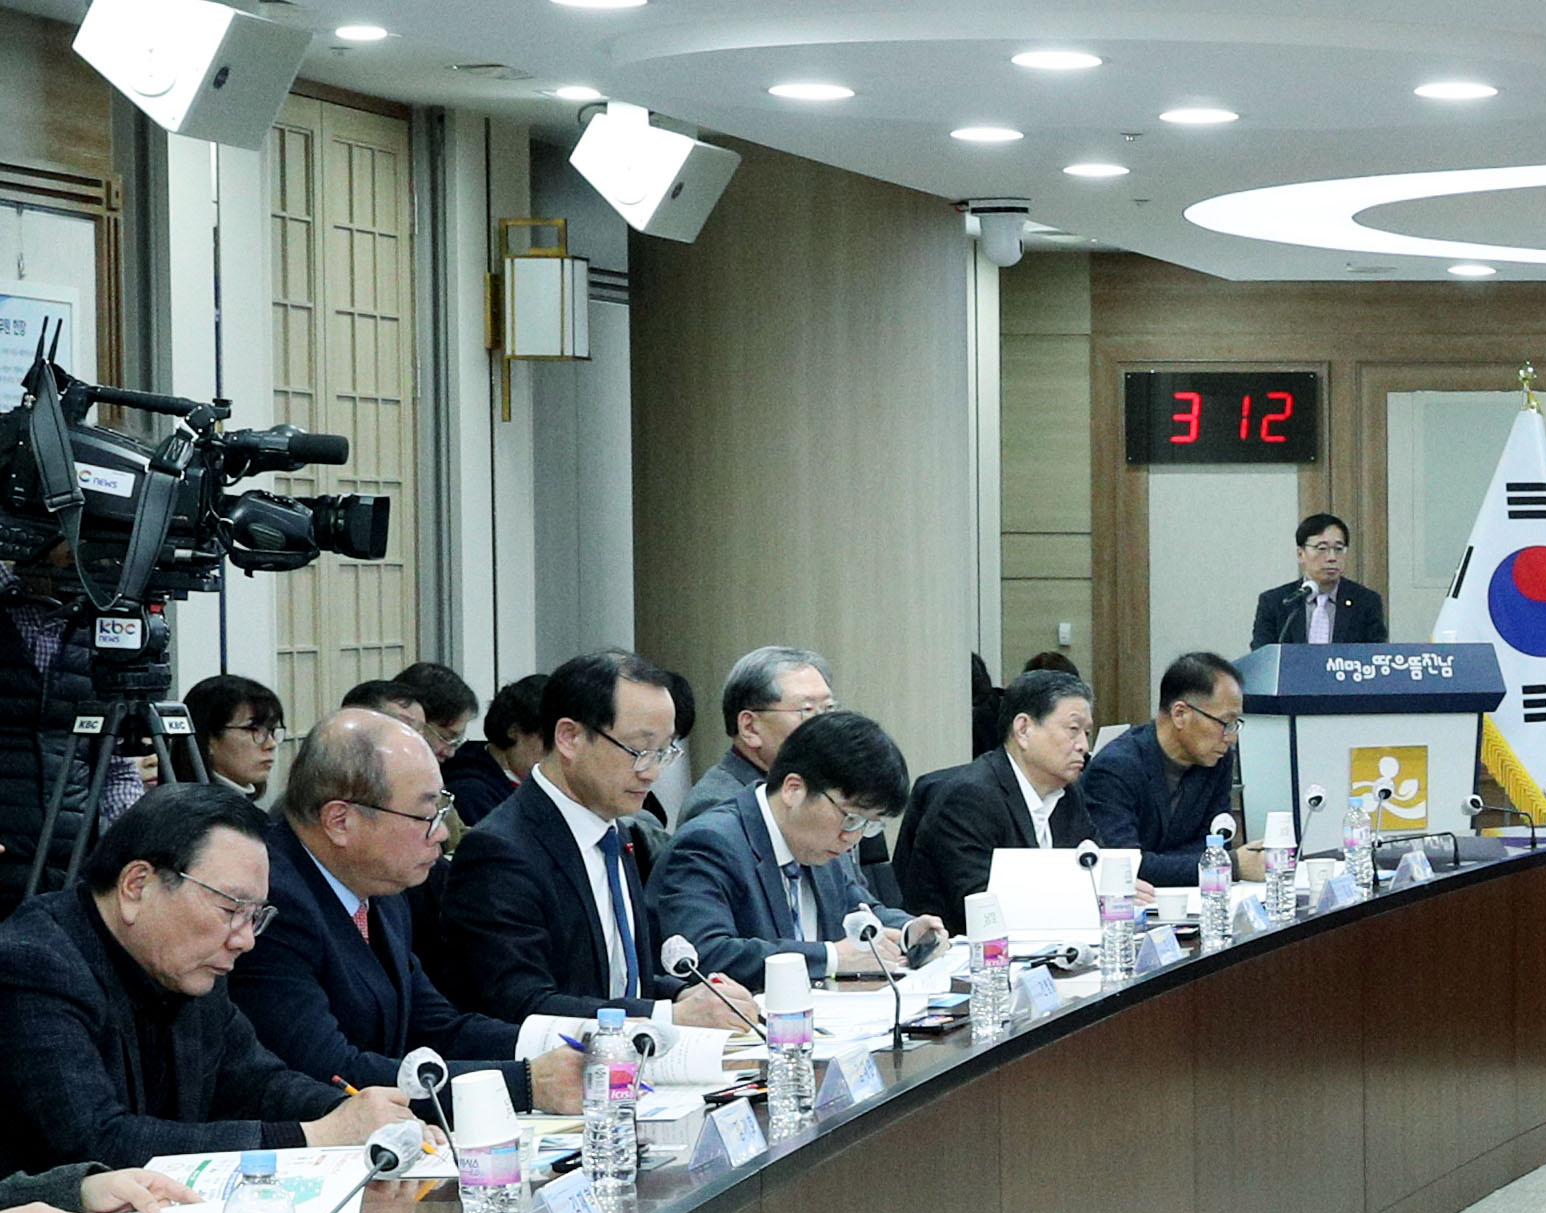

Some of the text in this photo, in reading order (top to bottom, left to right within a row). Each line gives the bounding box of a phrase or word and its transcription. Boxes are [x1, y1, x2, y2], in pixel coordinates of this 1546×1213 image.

[1169, 390, 1295, 444] 3 12
[99, 619, 137, 635] kbc
[78, 720, 99, 730] KBC
